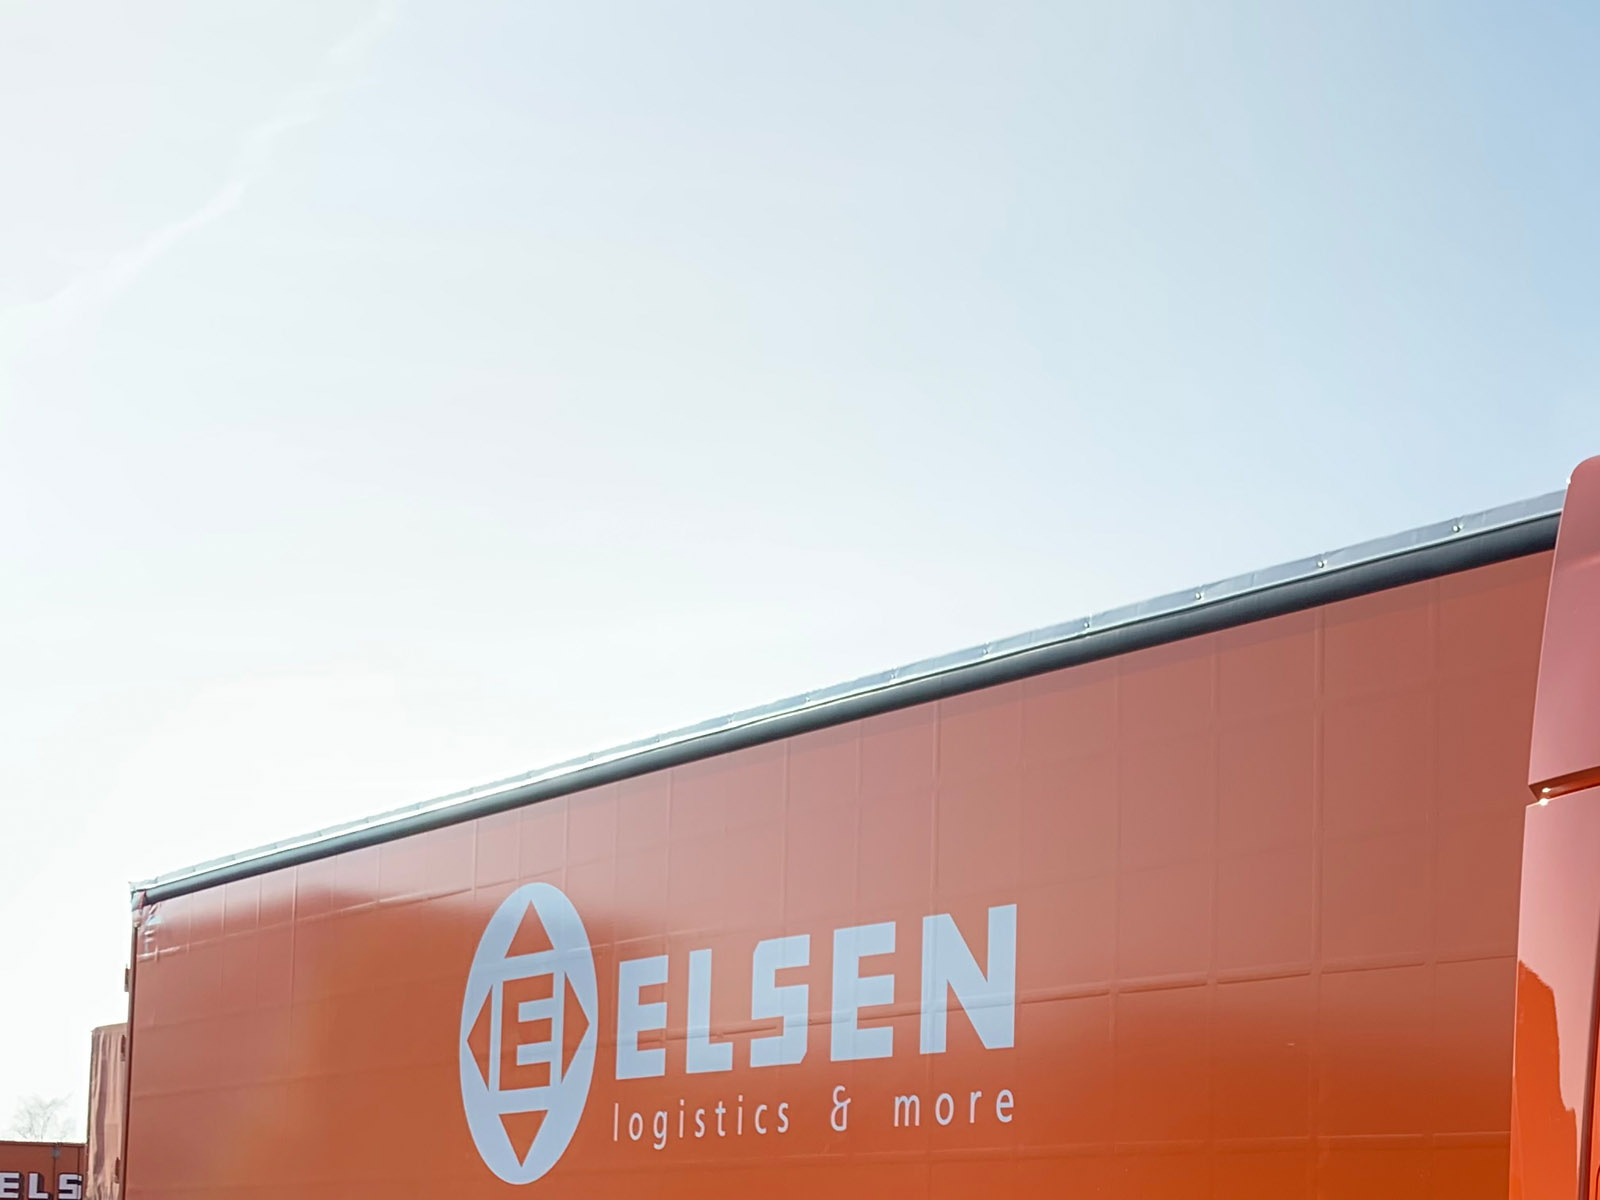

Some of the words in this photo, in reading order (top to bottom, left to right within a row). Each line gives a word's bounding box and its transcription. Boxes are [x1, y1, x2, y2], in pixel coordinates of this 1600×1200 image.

[615, 903, 1018, 1081] ELSEN
[613, 1094, 790, 1151] logistics
[830, 1086, 851, 1132] &
[894, 1088, 1015, 1128] more
